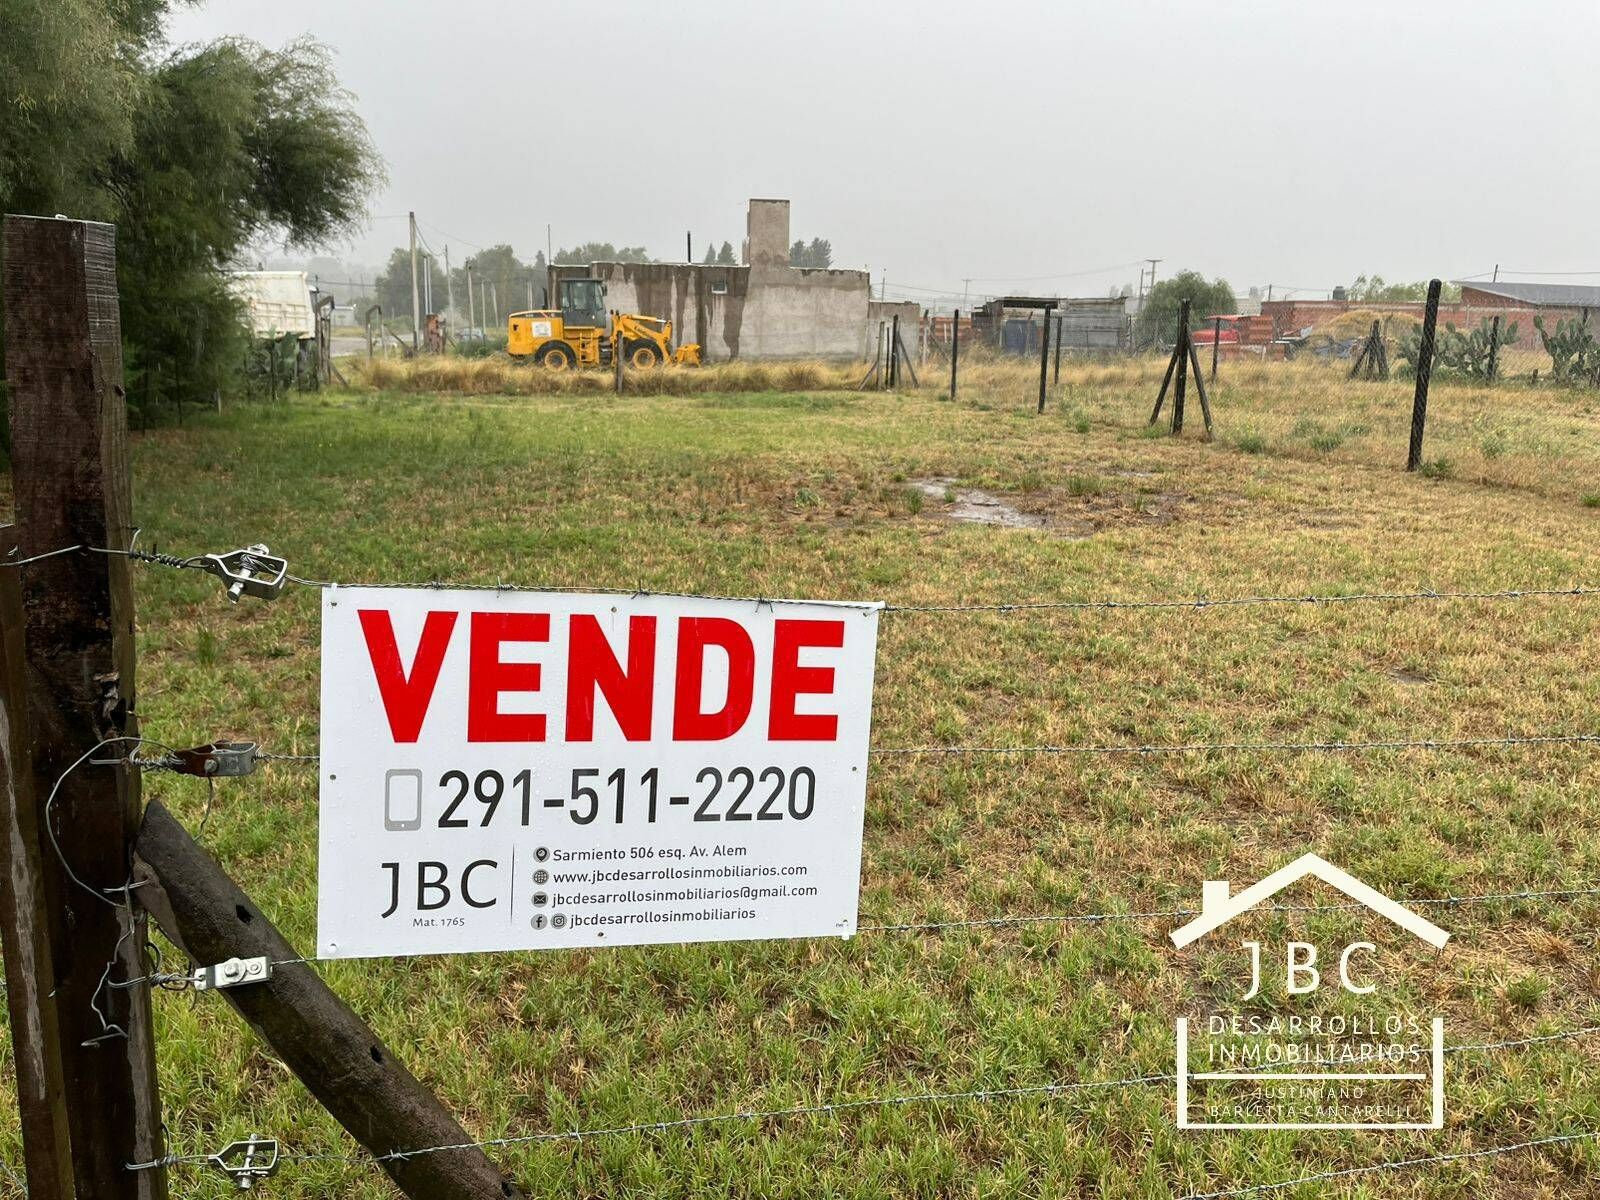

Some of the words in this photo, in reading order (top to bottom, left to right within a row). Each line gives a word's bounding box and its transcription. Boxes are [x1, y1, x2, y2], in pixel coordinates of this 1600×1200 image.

[357, 609, 845, 743] VENDE
[438, 766, 816, 828] 291-511-2220
[553, 848, 626, 861] Sarmiento
[630, 846, 654, 859] 506
[658, 848, 686, 860] esq.
[689, 846, 709, 857] Av.
[712, 844, 747, 857] Alem
[553, 864, 808, 884] www.jbcdesarrollosinmobiliarios.com
[381, 859, 498, 919] JBC
[552, 885, 818, 908] jbcdesarrollosinmobiliarios@gmail.com
[412, 918, 438, 927] Mat.
[441, 917, 465, 927] 1765
[569, 907, 756, 929] jbcdesarrollosinmobiliarios
